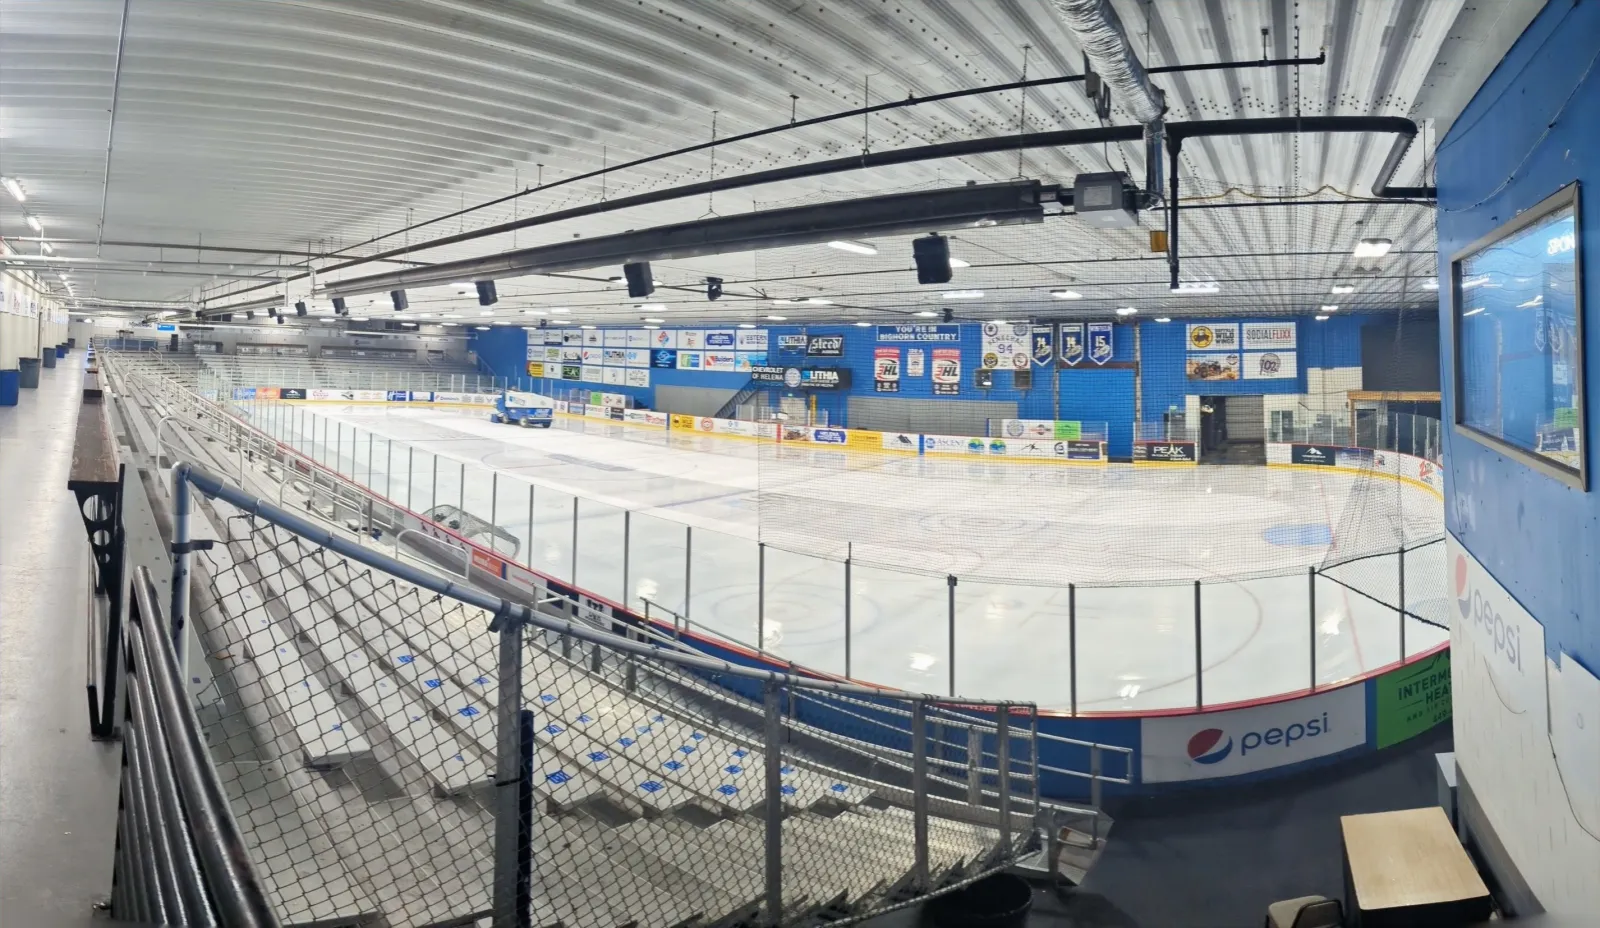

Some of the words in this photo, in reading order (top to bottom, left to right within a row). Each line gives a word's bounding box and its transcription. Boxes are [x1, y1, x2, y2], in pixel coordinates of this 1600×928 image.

[997, 343, 1013, 354] 94
[810, 370, 840, 380] LITHIA
[1153, 444, 1184, 455] PEAK
[1474, 588, 1522, 673] pepsi
[1241, 712, 1329, 756] pepsi
